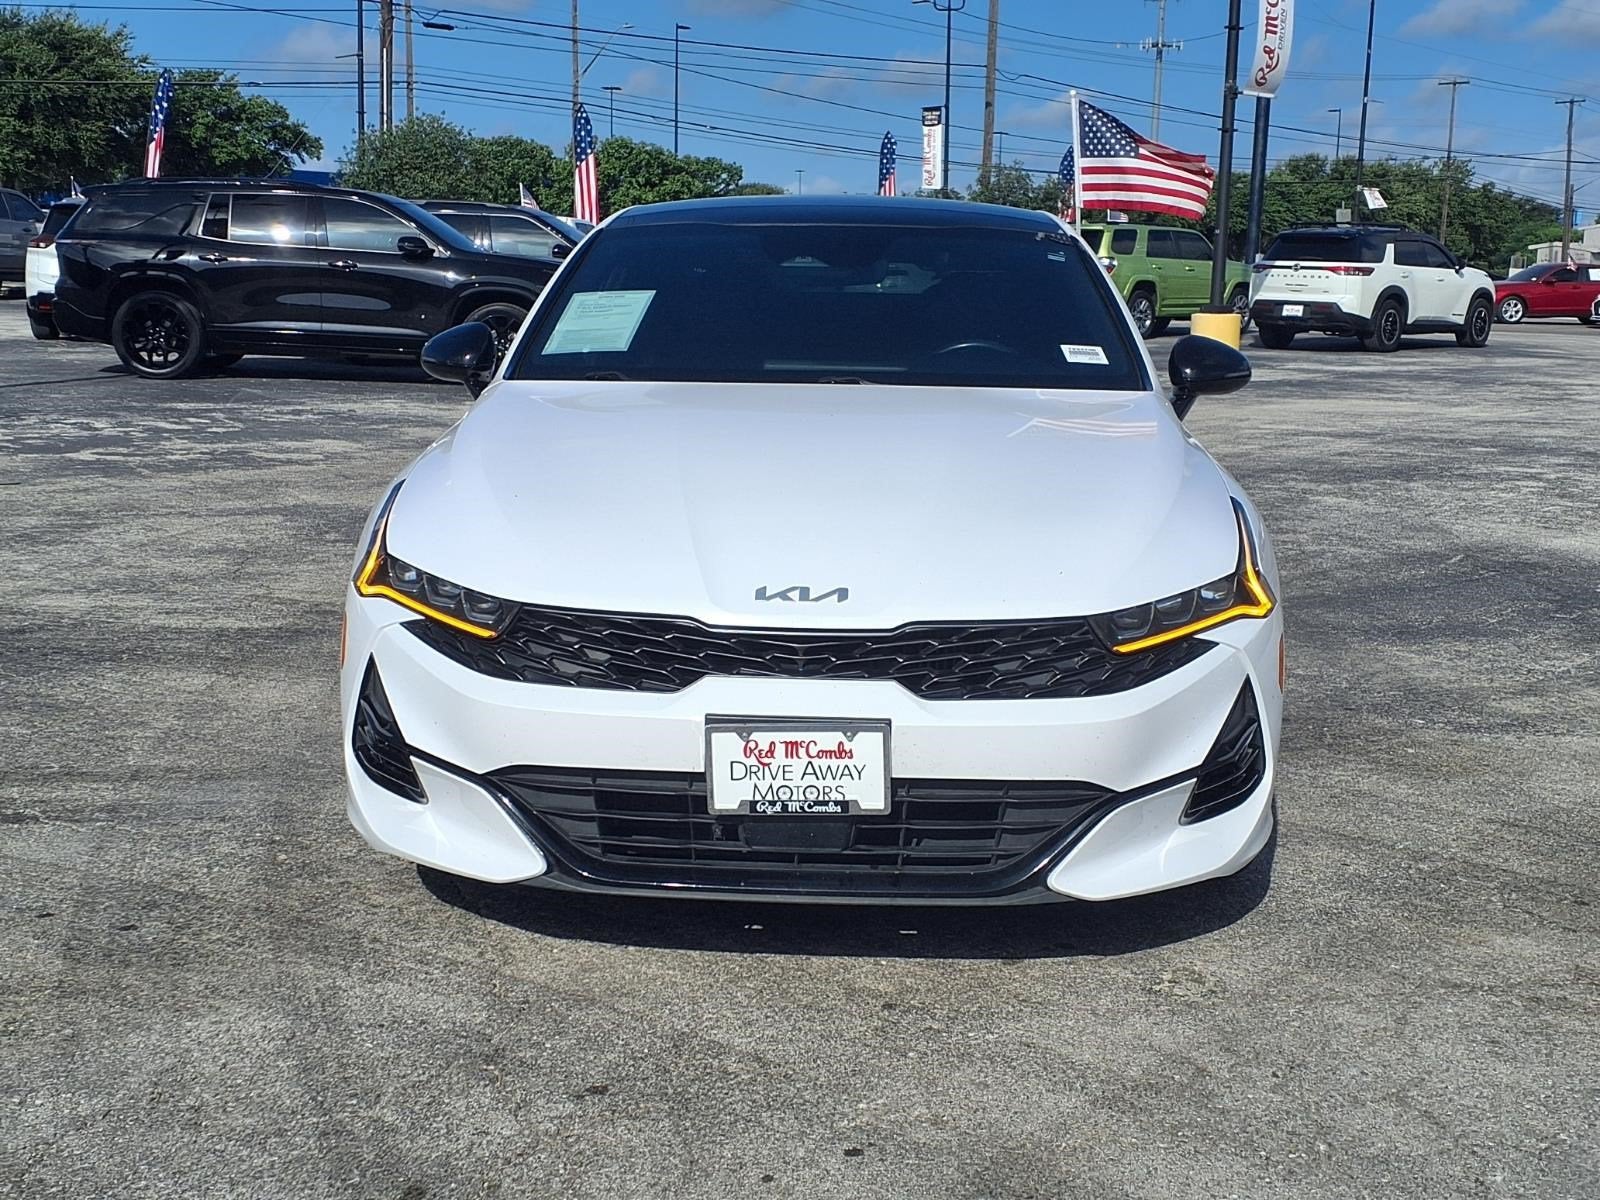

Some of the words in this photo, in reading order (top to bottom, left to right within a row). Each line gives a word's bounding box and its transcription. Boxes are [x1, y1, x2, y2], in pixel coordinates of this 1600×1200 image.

[1277, 8, 1287, 50] DRIVEN
[1255, 45, 1280, 87] Red
[755, 585, 849, 603] KIA
[743, 739, 776, 767] Red
[779, 740, 854, 760] McCombs
[756, 801, 782, 814] Red
[784, 801, 842, 813] McCombs
